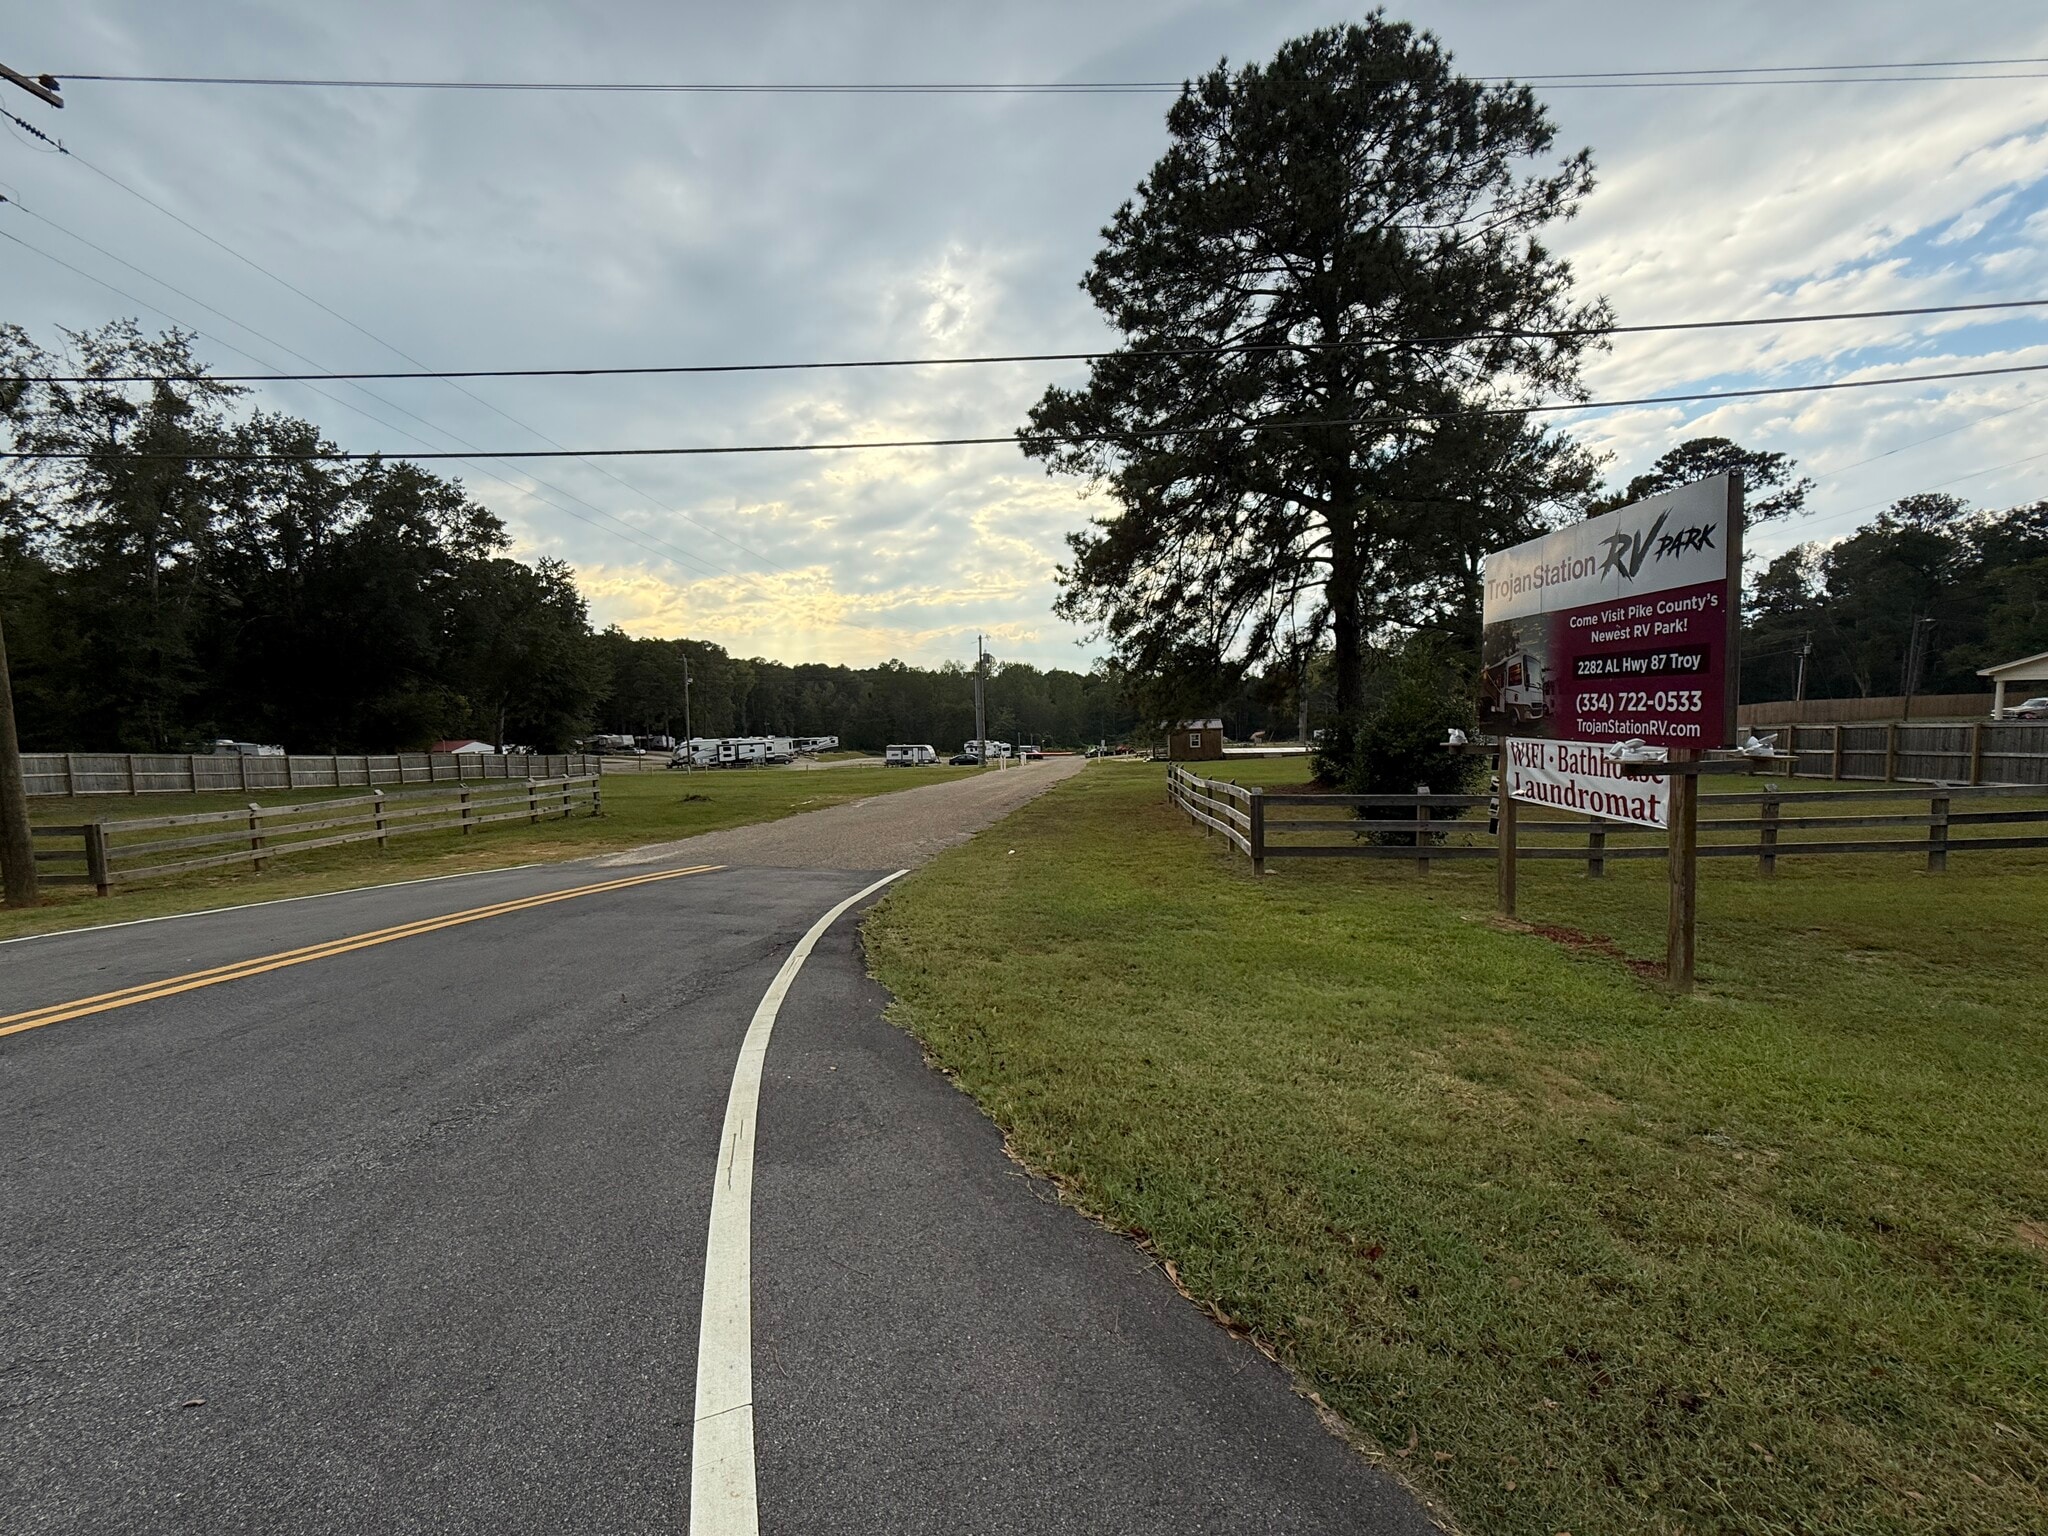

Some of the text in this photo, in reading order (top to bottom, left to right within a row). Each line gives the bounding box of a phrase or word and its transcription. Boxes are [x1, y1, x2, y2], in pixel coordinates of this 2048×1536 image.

[1487, 506, 1718, 601] TrojanStation RV PARK
[1569, 593, 1718, 628] Come Visit Pike County's
[1591, 618, 1688, 643] Newest RV Park!
[1577, 653, 1702, 675] 2282 AL Hwy 87 Troy
[1576, 690, 1702, 714] (334) 722-0533
[1576, 718, 1701, 737] TrojanStationRV.com
[1510, 741, 1664, 784] WIFI Bathho
[1514, 772, 1662, 823] Laundromat
